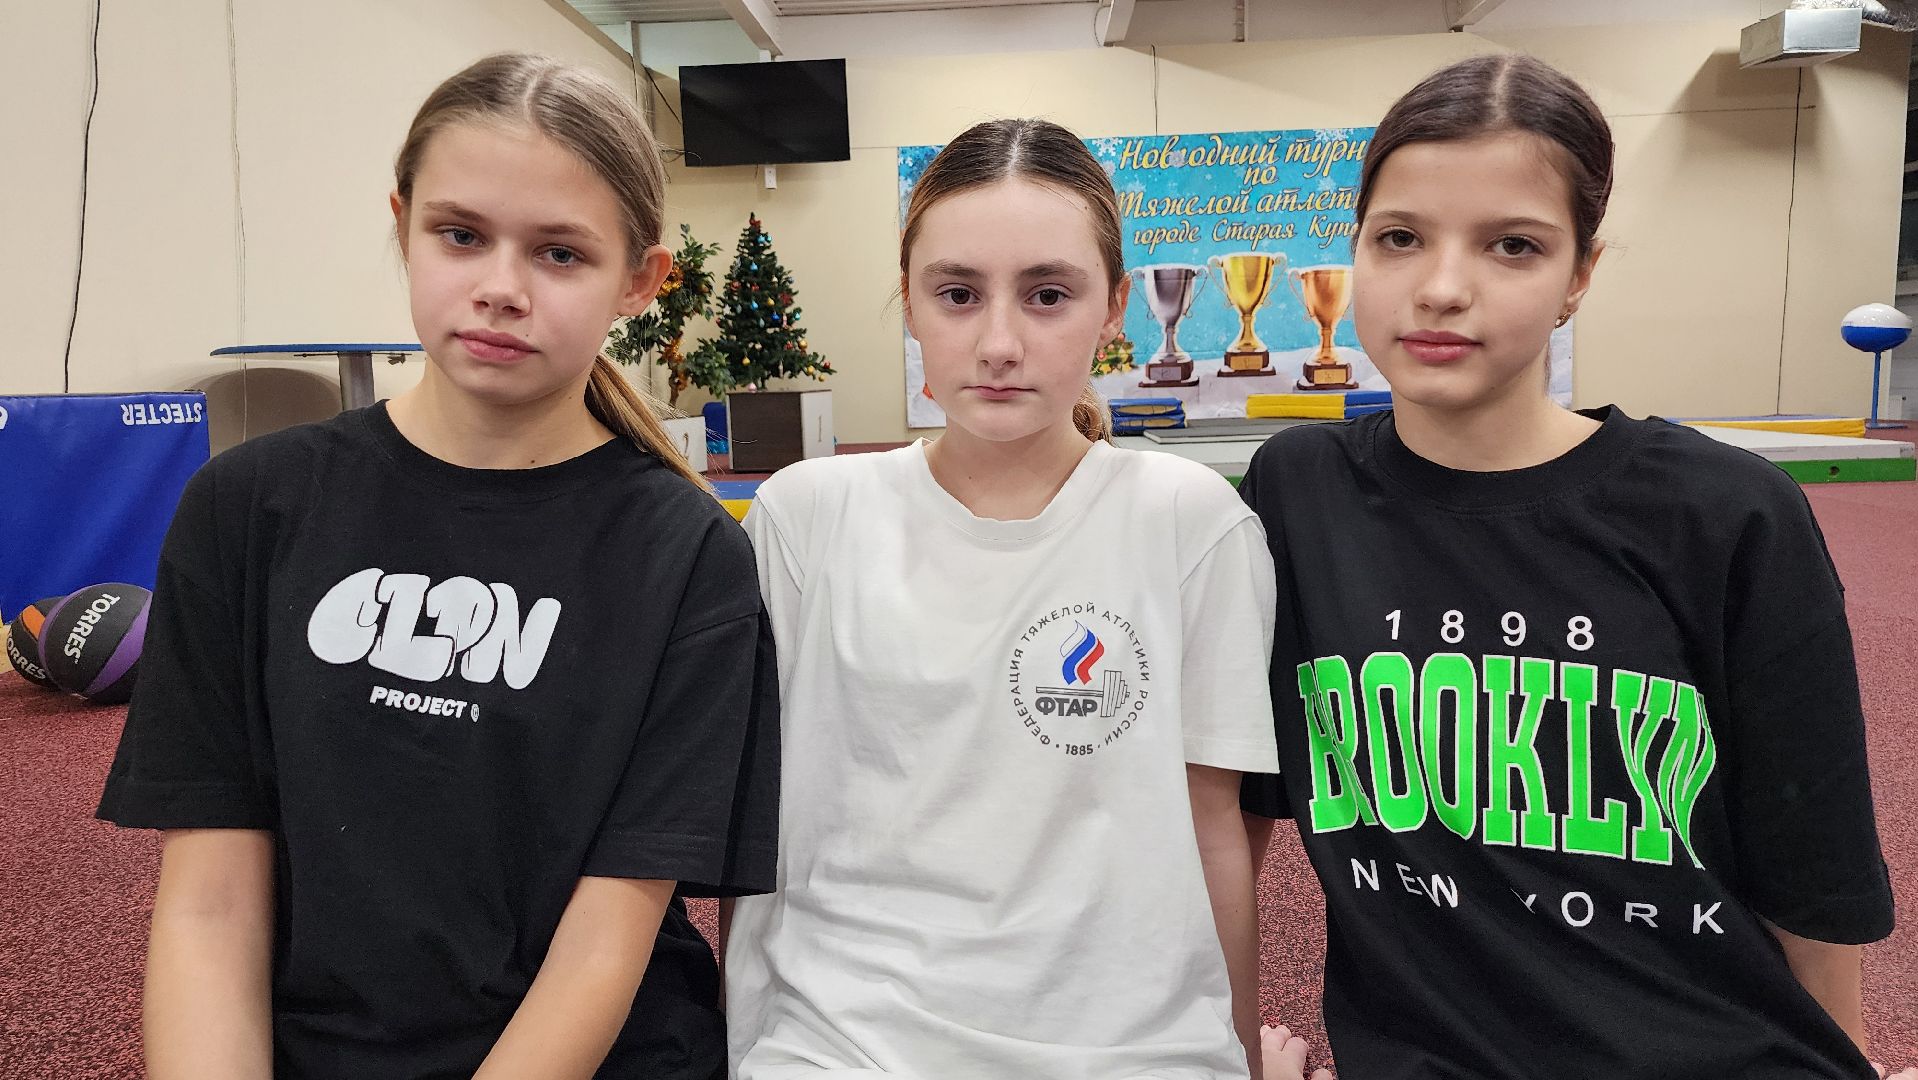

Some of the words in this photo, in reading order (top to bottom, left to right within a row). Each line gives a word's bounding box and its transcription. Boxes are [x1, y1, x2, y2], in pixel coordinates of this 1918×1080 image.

[1243, 165, 1278, 186] по
[1284, 137, 1366, 179] турн
[1118, 187, 1253, 219] Тяжелой
[1133, 219, 1201, 256] городе
[1212, 218, 1297, 251] Старая
[120, 402, 203, 426] STECTER
[64, 593, 121, 661] TORRES
[1021, 601, 1095, 643] ТЯЖЕЛОЙ
[1385, 609, 1596, 651] 1898
[1102, 610, 1150, 681] АТЛЕТИКИ
[369, 685, 467, 719] PROJECT
[1009, 648, 1050, 745] ФЕДЕРАЦИЯ
[1035, 696, 1098, 717] ФТАР
[1104, 689, 1149, 746] РОССИИ
[1065, 743, 1093, 756] 1885
[1297, 651, 1716, 871] BROOKLYN
[1350, 857, 1459, 908] NEW
